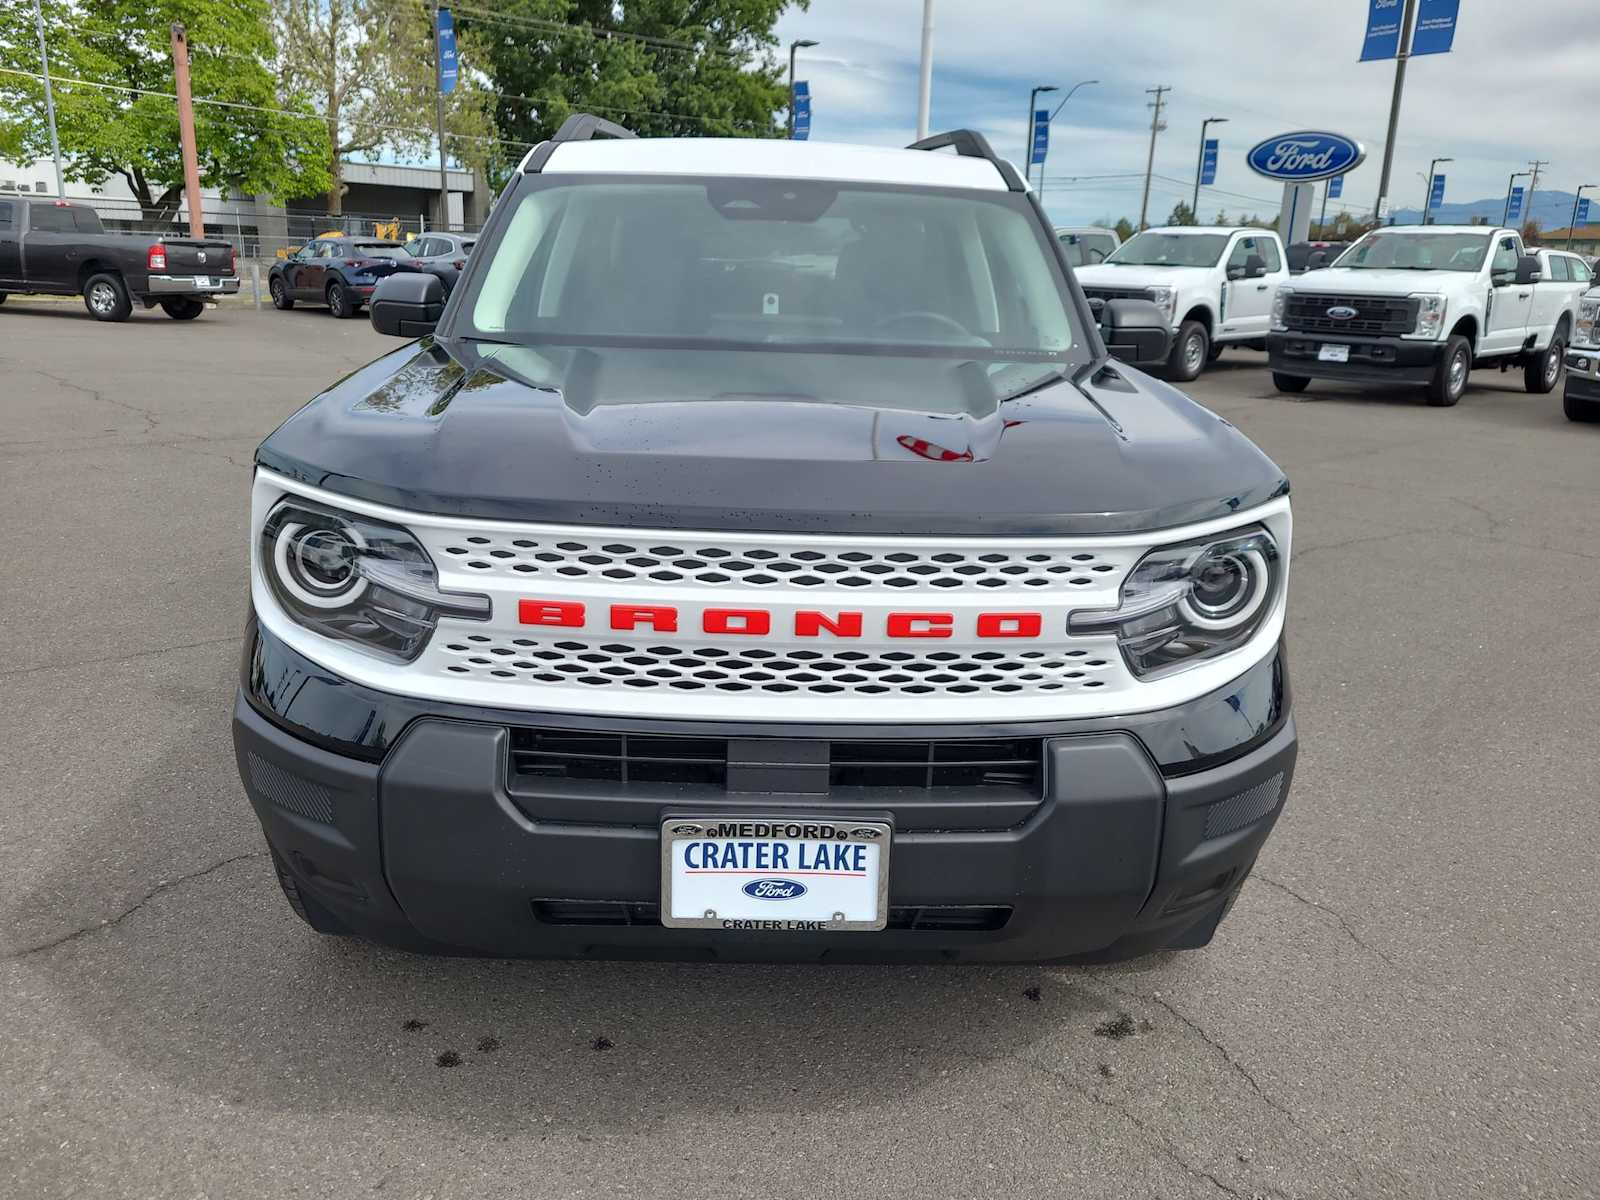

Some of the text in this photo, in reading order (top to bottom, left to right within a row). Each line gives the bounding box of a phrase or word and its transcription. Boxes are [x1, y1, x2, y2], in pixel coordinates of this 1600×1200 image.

[1266, 140, 1337, 171] Ford
[517, 598, 1042, 639] BRONCO
[718, 823, 835, 840] MEDFORD
[684, 842, 867, 871] CRATER LAKE
[754, 881, 794, 898] Ford
[722, 919, 827, 931] CRATER LAKE
